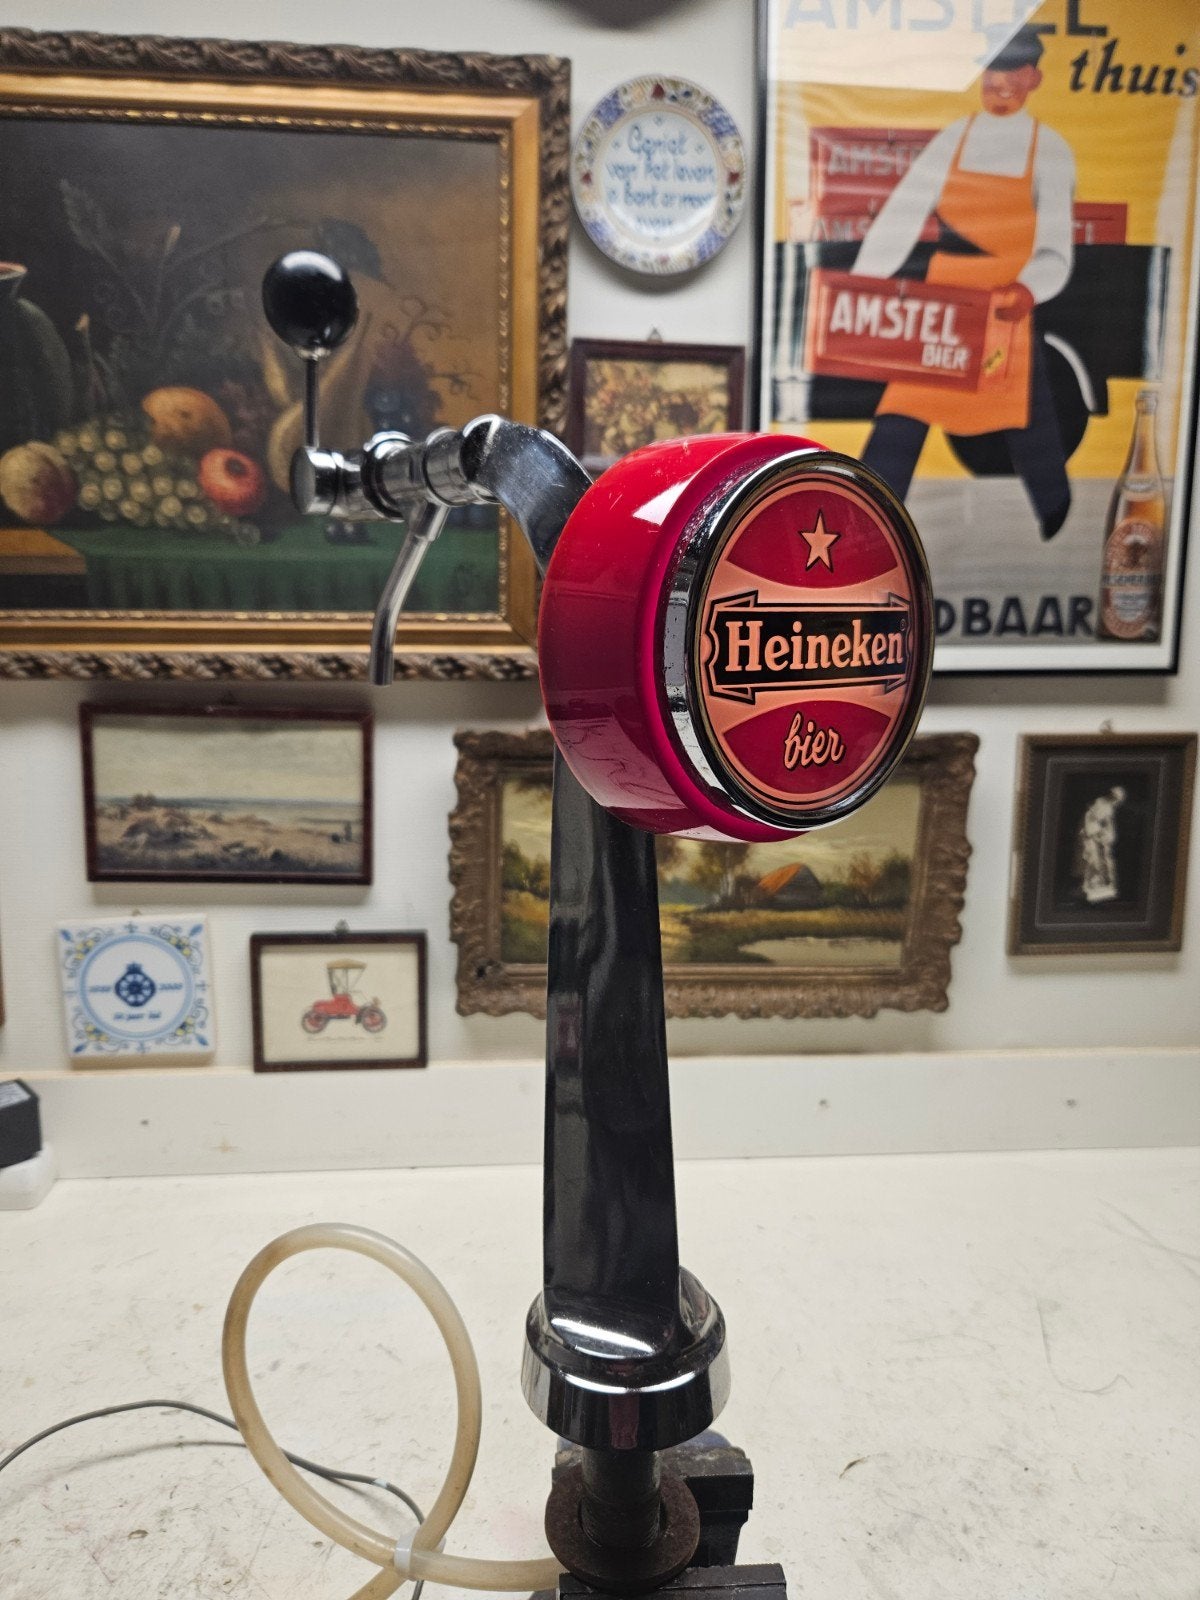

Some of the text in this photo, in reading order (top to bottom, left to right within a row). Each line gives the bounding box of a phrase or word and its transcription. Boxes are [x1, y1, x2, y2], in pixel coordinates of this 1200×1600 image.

[1070, 37, 1200, 96] thuis
[829, 290, 960, 346] AMSTEL
[920, 343, 970, 371] BIER
[725, 619, 904, 672] Heineken
[783, 711, 846, 770] bier
